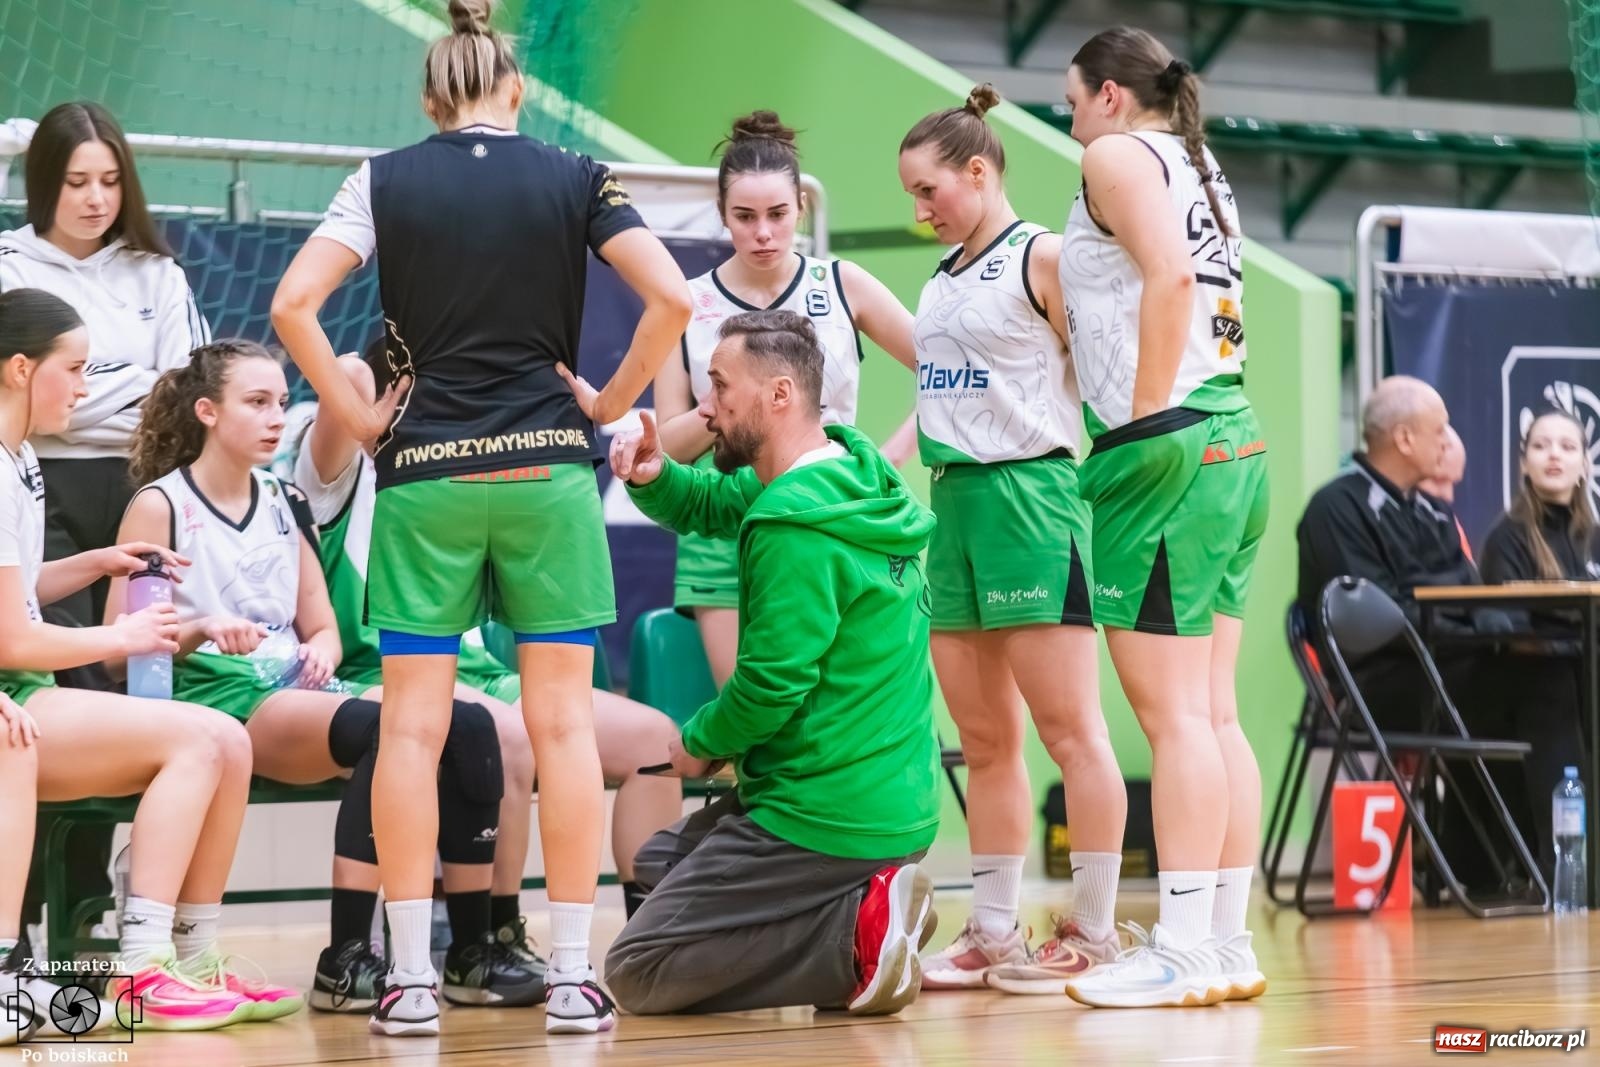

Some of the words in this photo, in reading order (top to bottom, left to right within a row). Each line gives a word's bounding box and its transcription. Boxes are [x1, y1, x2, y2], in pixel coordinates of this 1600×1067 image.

[806, 289, 831, 317] 8
[1010, 586, 1048, 603] studio
[1348, 795, 1396, 884] 5
